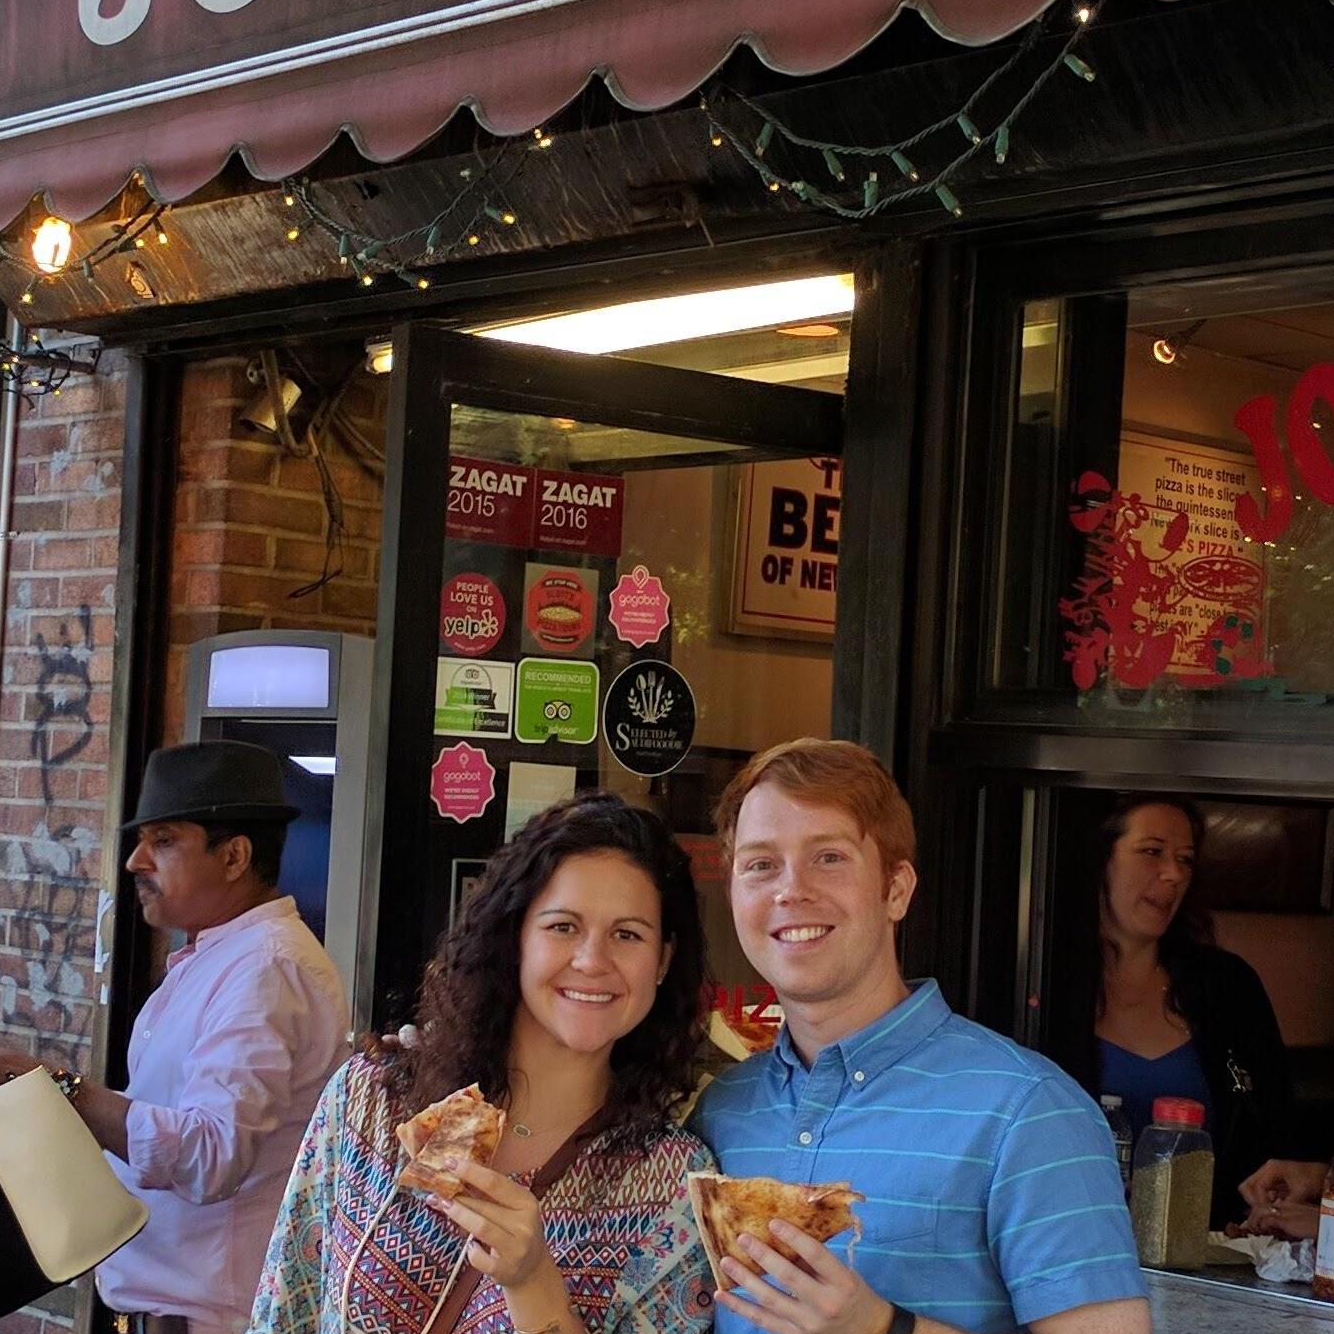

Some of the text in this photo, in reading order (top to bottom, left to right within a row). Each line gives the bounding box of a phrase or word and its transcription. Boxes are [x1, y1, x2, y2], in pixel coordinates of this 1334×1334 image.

[449, 466, 527, 497] ZAGAT
[1192, 463, 1213, 480] true
[1216, 469, 1246, 486] street
[542, 480, 616, 508] ZAGAT
[1155, 475, 1183, 493] pizza
[1186, 480, 1195, 496] is
[1198, 483, 1214, 498] the
[447, 489, 495, 517] 2015
[540, 504, 588, 529] 2016
[1203, 522, 1228, 539] slice
[1231, 525, 1240, 541] is
[761, 553, 837, 591] OF NE
[450, 591, 494, 606] LOVE US
[456, 581, 489, 594] PEOPLE
[618, 593, 660, 608] gogobot
[444, 615, 481, 640] yelp
[524, 671, 592, 685] RECOMMENDED
[443, 770, 482, 784] gogobot
